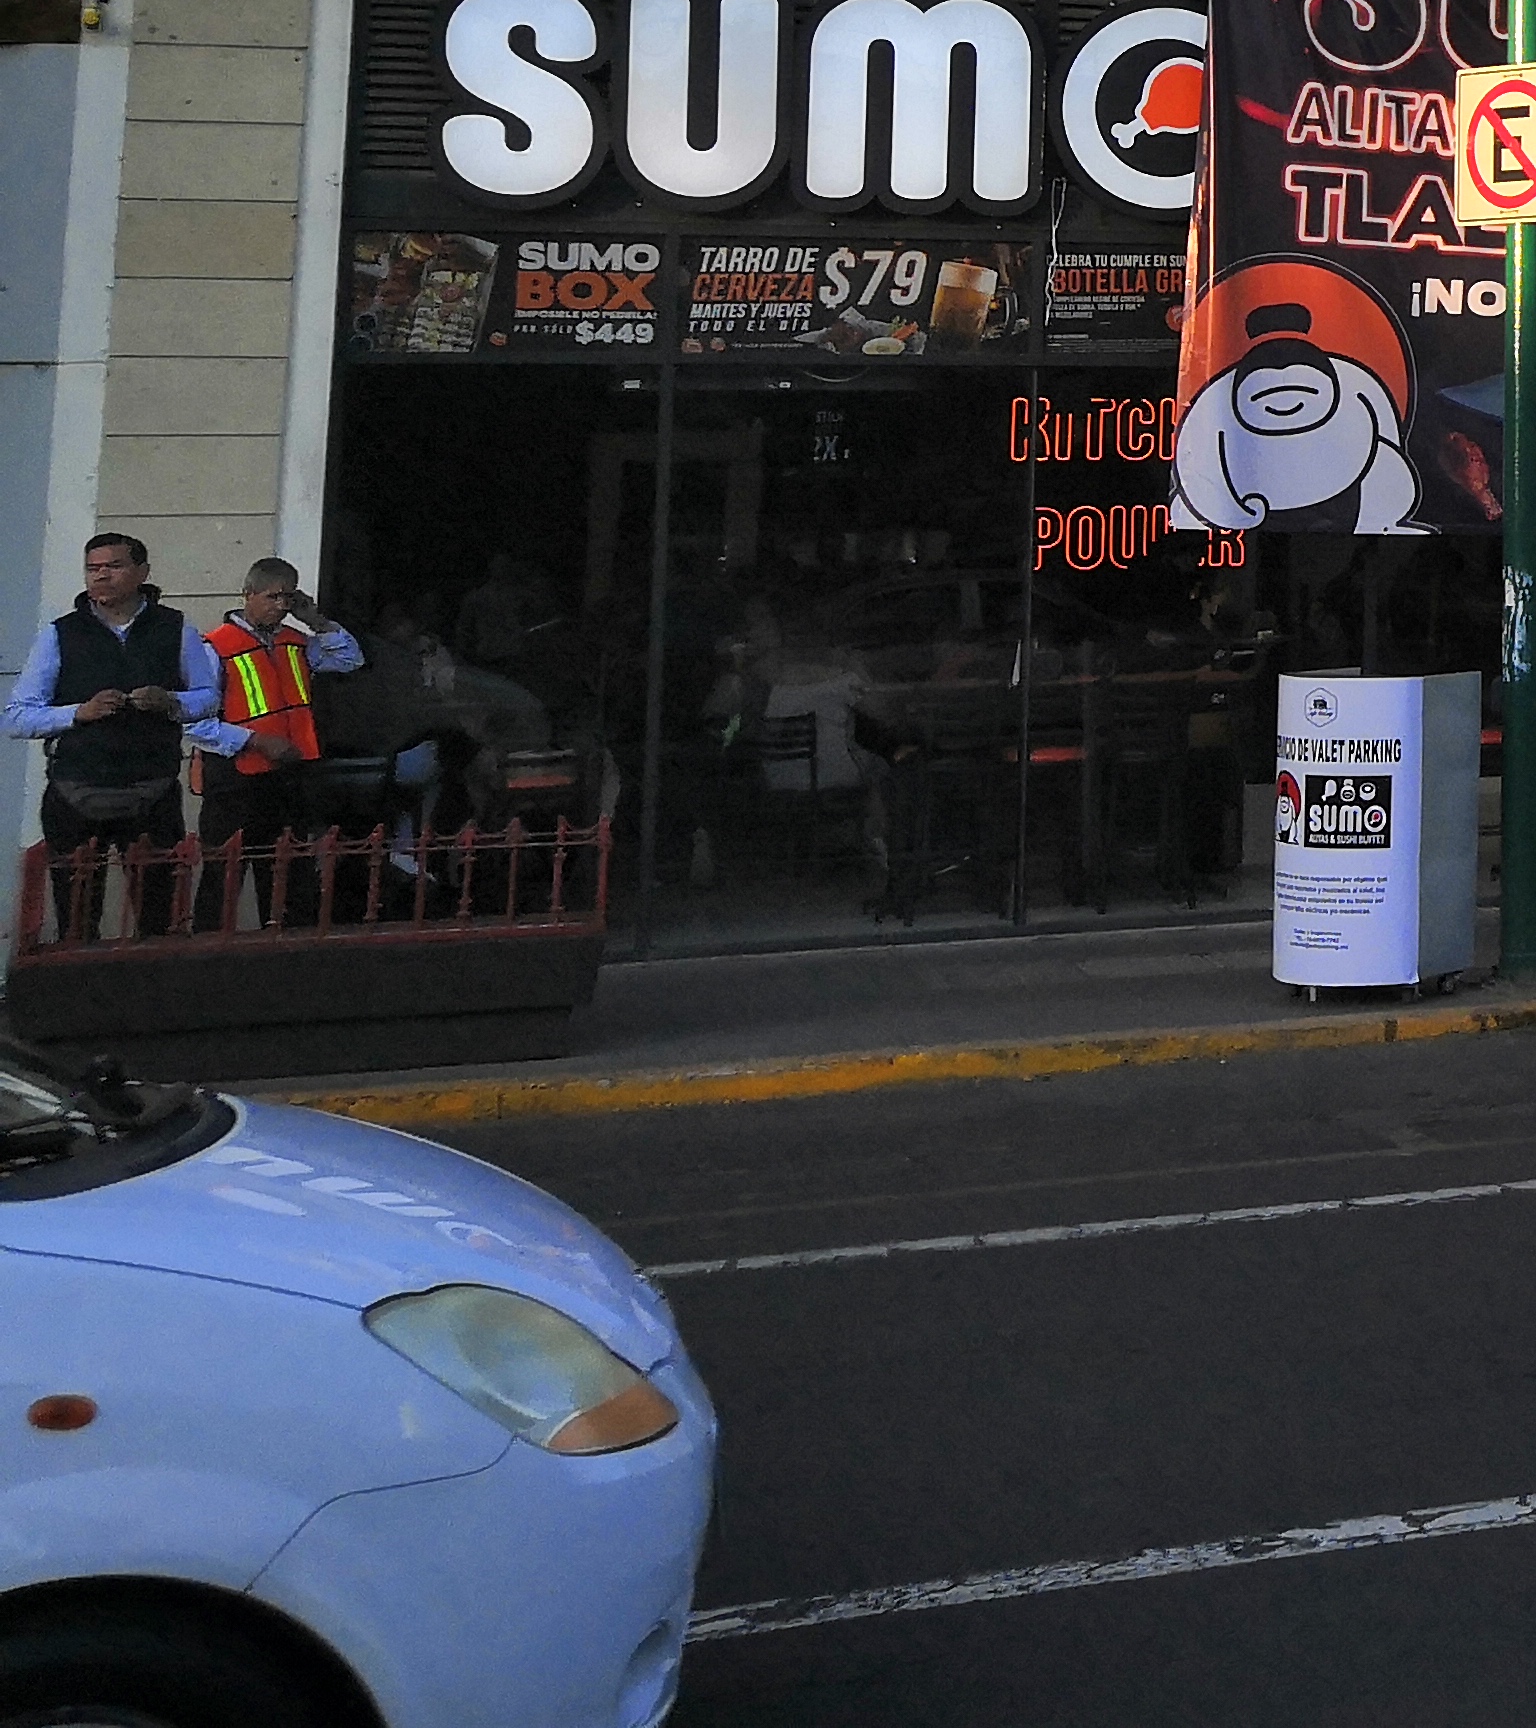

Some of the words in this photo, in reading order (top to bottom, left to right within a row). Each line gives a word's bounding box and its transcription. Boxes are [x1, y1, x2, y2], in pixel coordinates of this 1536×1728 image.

[1288, 82, 1457, 156] ALITA
[518, 241, 661, 272] SUMO
[700, 246, 779, 273] TARRO
[785, 246, 820, 273] DE
[1094, 255, 1109, 267] TU
[1110, 255, 1151, 267] CUMPLE
[1153, 255, 1168, 267] EN
[515, 271, 655, 311] BOX
[692, 273, 814, 302] CERVEZA
[819, 246, 927, 310] $79
[1053, 268, 1149, 294] BOTELLA
[689, 303, 747, 319] MARTES
[749, 303, 762, 319] Y
[760, 303, 813, 318] JUEVES
[1411, 277, 1507, 318] ¡NO
[574, 320, 655, 345] $449
[689, 320, 735, 333] TODO
[746, 320, 766, 332] EL
[778, 318, 809, 331] DÍA
[1298, 738, 1309, 761] DE
[1311, 739, 1346, 763] VALET
[1348, 738, 1402, 763] PARKING
[1309, 804, 1387, 833] SUMO
